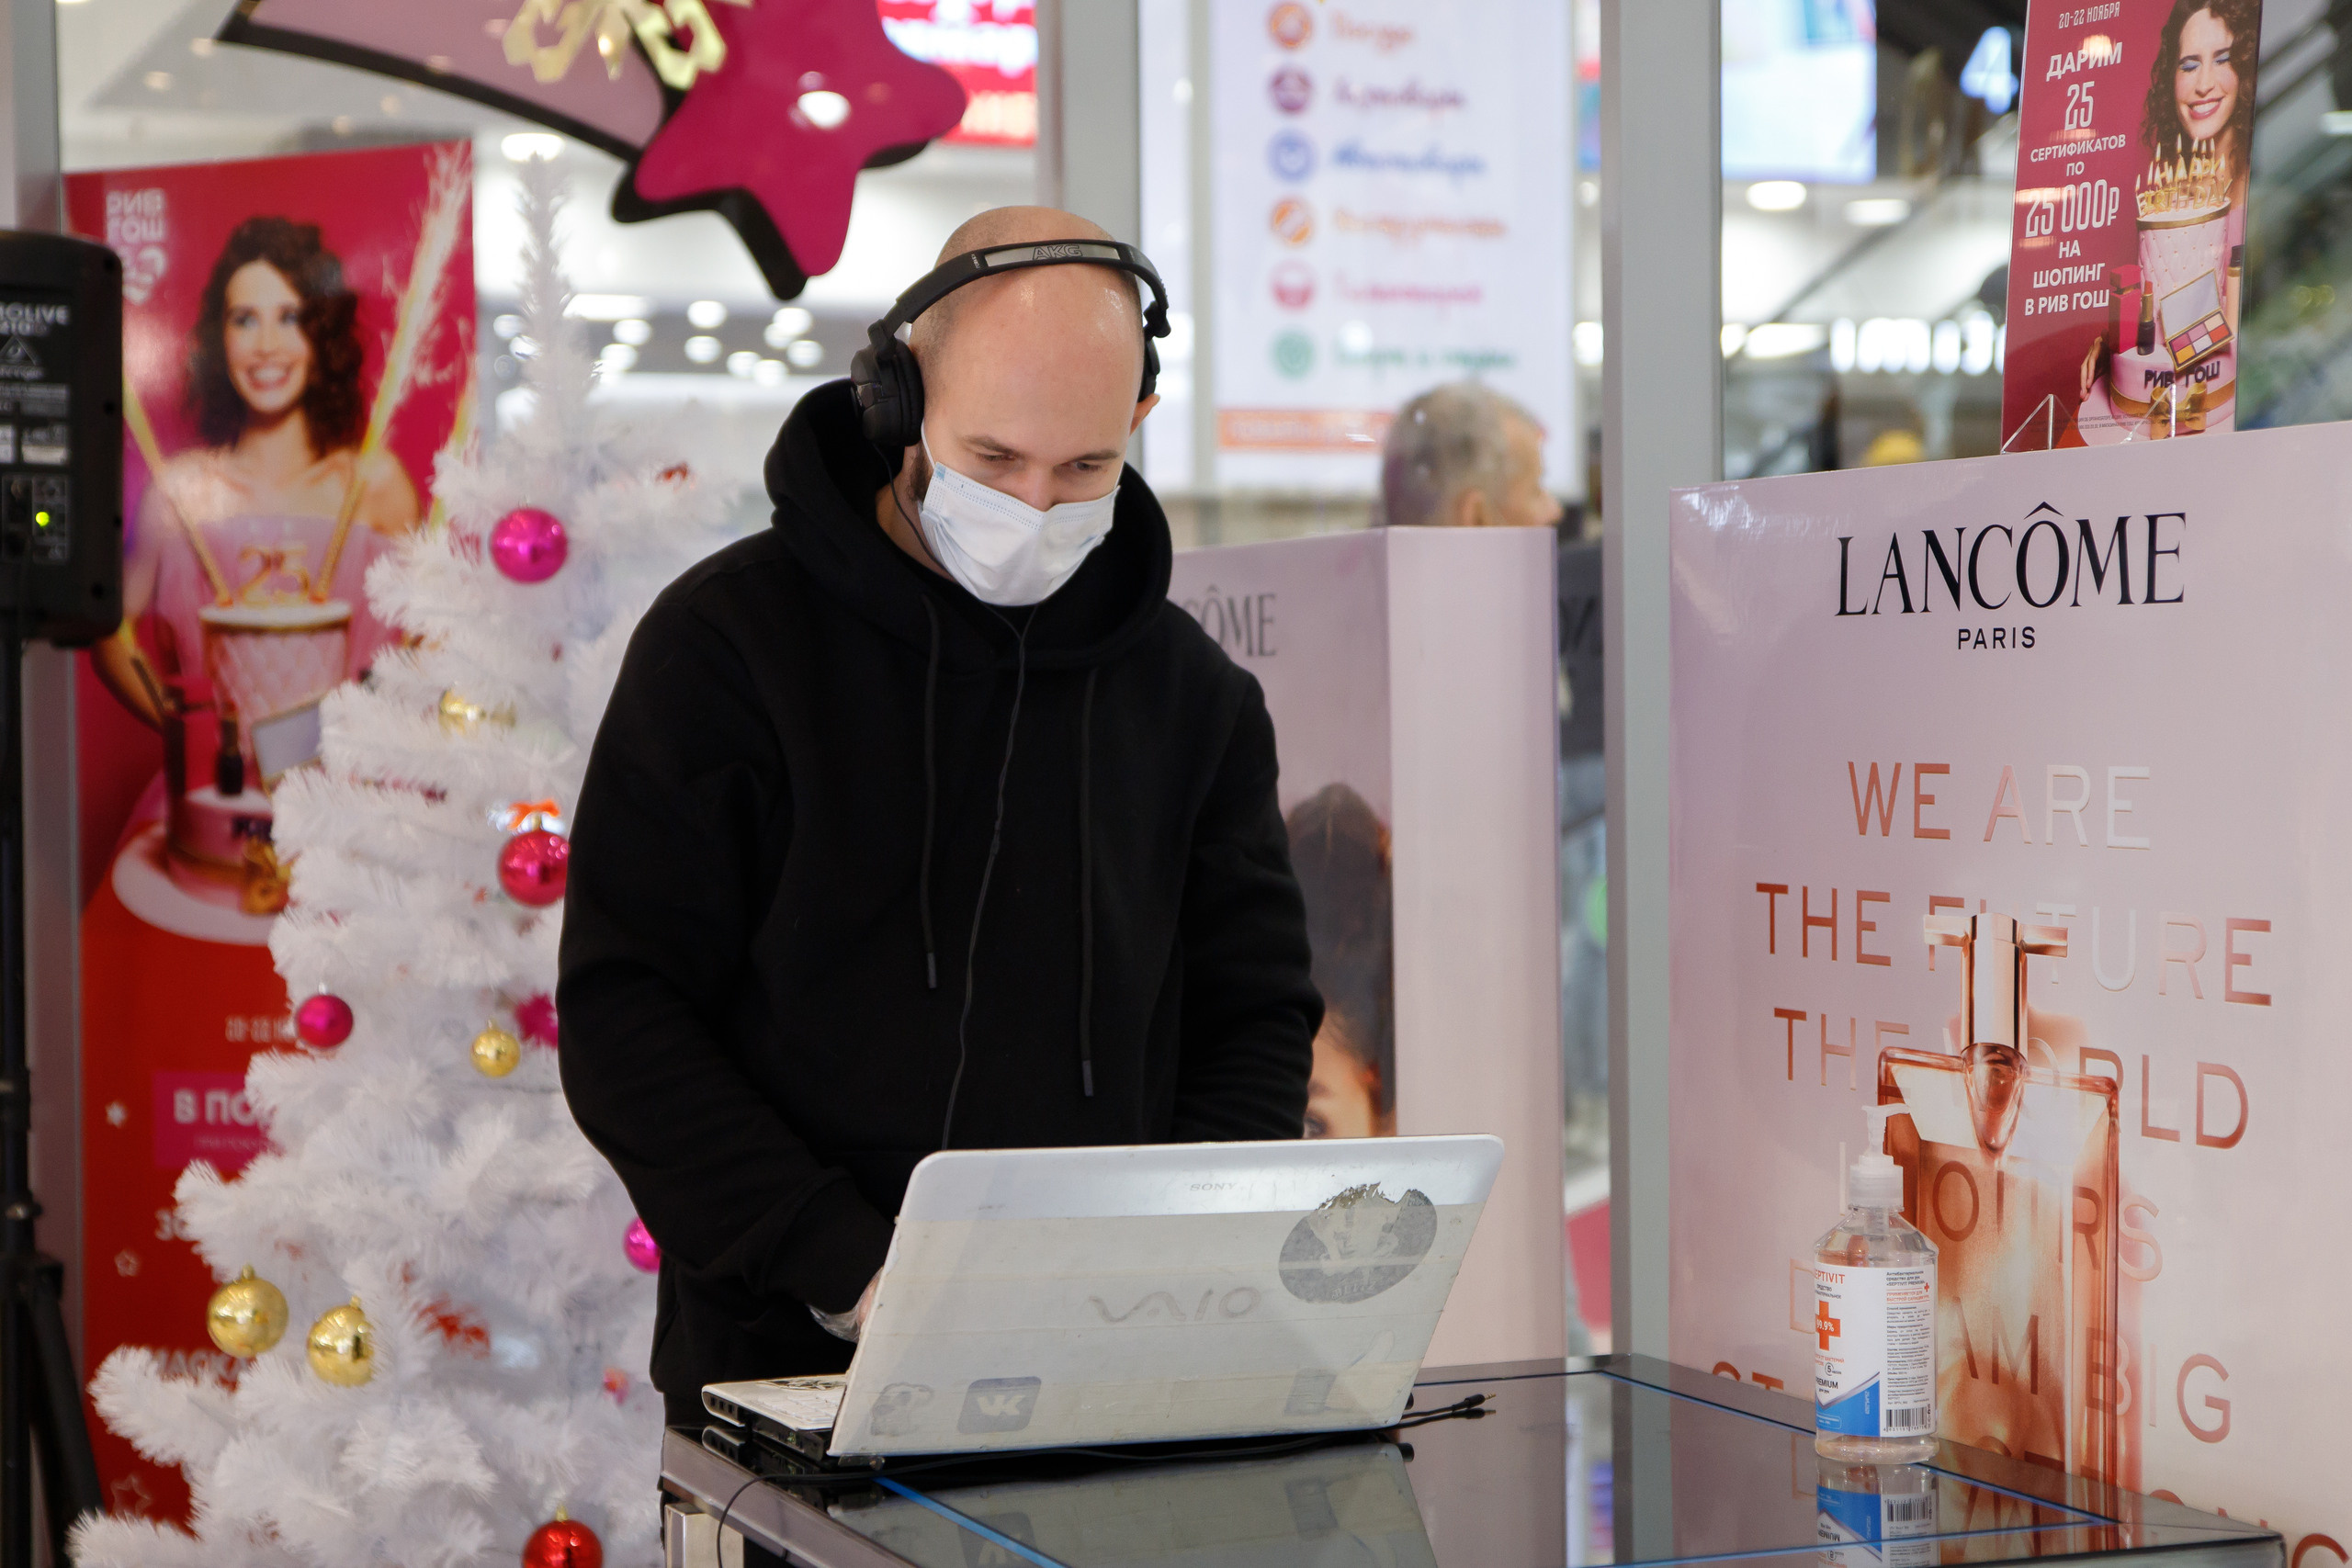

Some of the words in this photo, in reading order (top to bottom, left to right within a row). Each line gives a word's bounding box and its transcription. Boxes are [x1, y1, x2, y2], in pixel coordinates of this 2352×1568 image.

[2058, 9, 2085, 29] 20-22
[2086, 1, 2120, 23] НОЯБРЯ
[2045, 41, 2122, 82] ДАРИМ
[2064, 81, 2095, 130] 25
[2030, 134, 2126, 163] СЕРТИФИКАТОВ
[2066, 162, 2085, 176] ПО
[1033, 244, 1082, 260] AKG
[2059, 240, 2081, 259] НА
[2033, 263, 2105, 288] ШОПИНГ
[2025, 299, 2034, 316] В
[2038, 294, 2068, 314] РИВ
[2073, 289, 2109, 310] ГОШ
[2144, 369, 2175, 389] РИВ
[2185, 361, 2220, 386] ГОШ
[1835, 502, 2187, 616] LANCÔME
[1958, 626, 2036, 650] PARIS
[1848, 761, 1951, 840] WE
[1984, 764, 2151, 850] ARE
[1757, 883, 1892, 966] THE
[1928, 894, 2272, 1007] FTURE
[1190, 1182, 1237, 1191] SONY
[1815, 1269, 1846, 1285] EPTIVIT
[1090, 1287, 1261, 1324] VAIO
[2086, 1325, 2231, 1444] BIG
